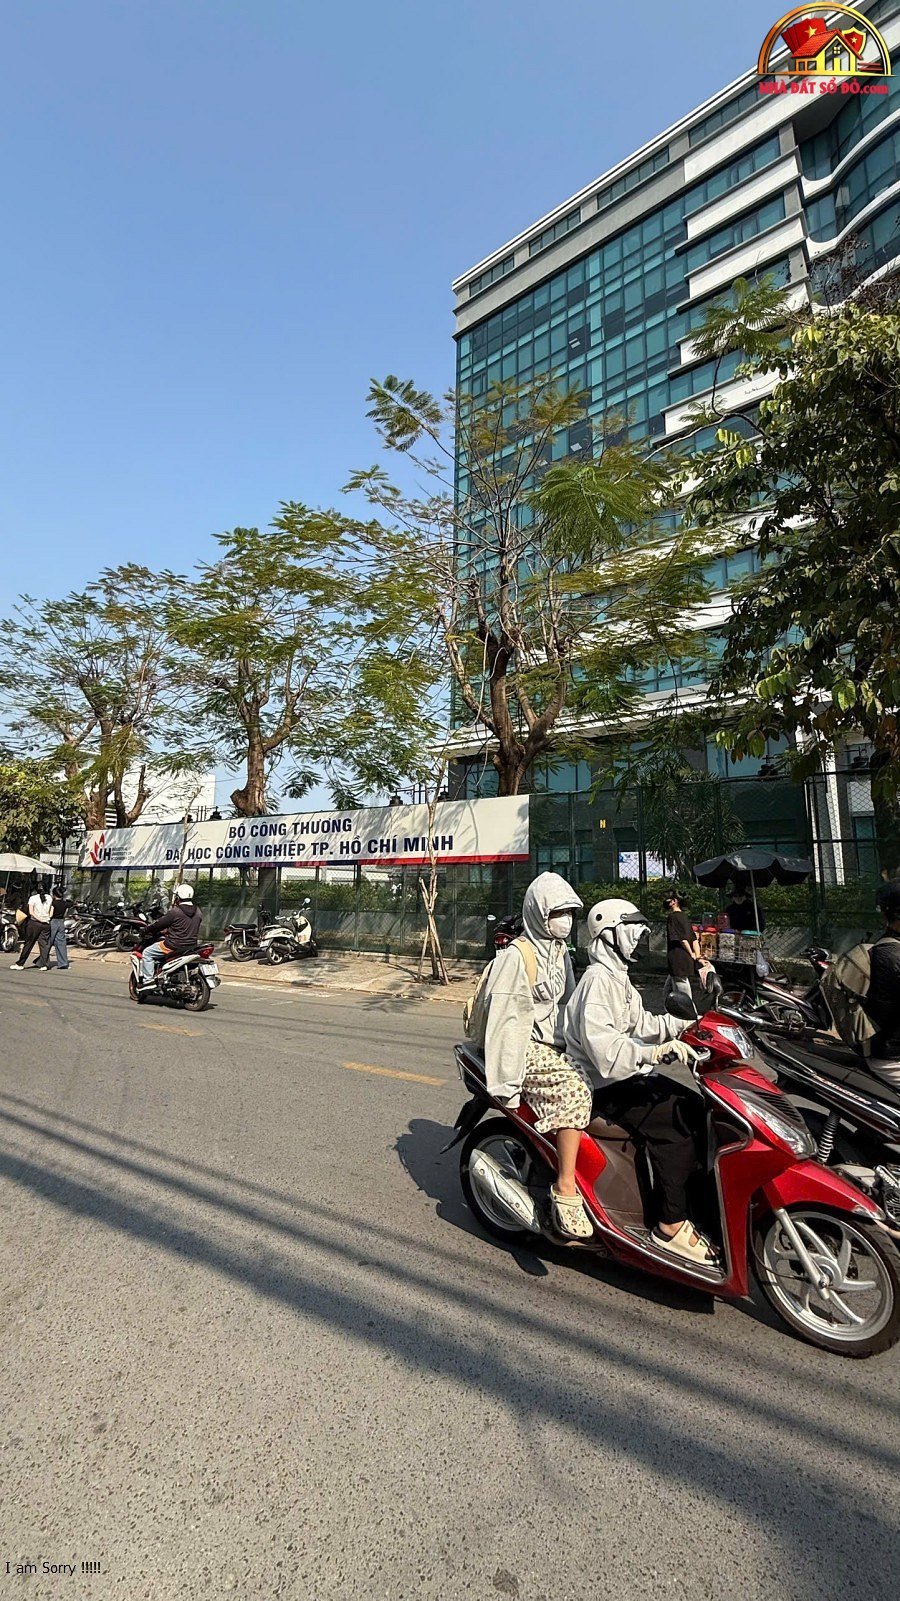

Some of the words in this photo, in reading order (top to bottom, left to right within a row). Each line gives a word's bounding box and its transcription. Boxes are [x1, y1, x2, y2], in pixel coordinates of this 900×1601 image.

[229, 822, 246, 841] BỘ
[250, 821, 287, 838] CÔNG
[292, 817, 352, 835] THƯƠNG
[165, 849, 181, 863] ĐẠ
[187, 847, 212, 862] HỌC
[215, 843, 250, 859] CÔNG
[255, 840, 306, 860] NGHIỆP
[311, 842, 333, 855] TP.
[340, 835, 362, 855] HỒ
[367, 834, 397, 853] CHÍ
[403, 835, 454, 852] MINH
